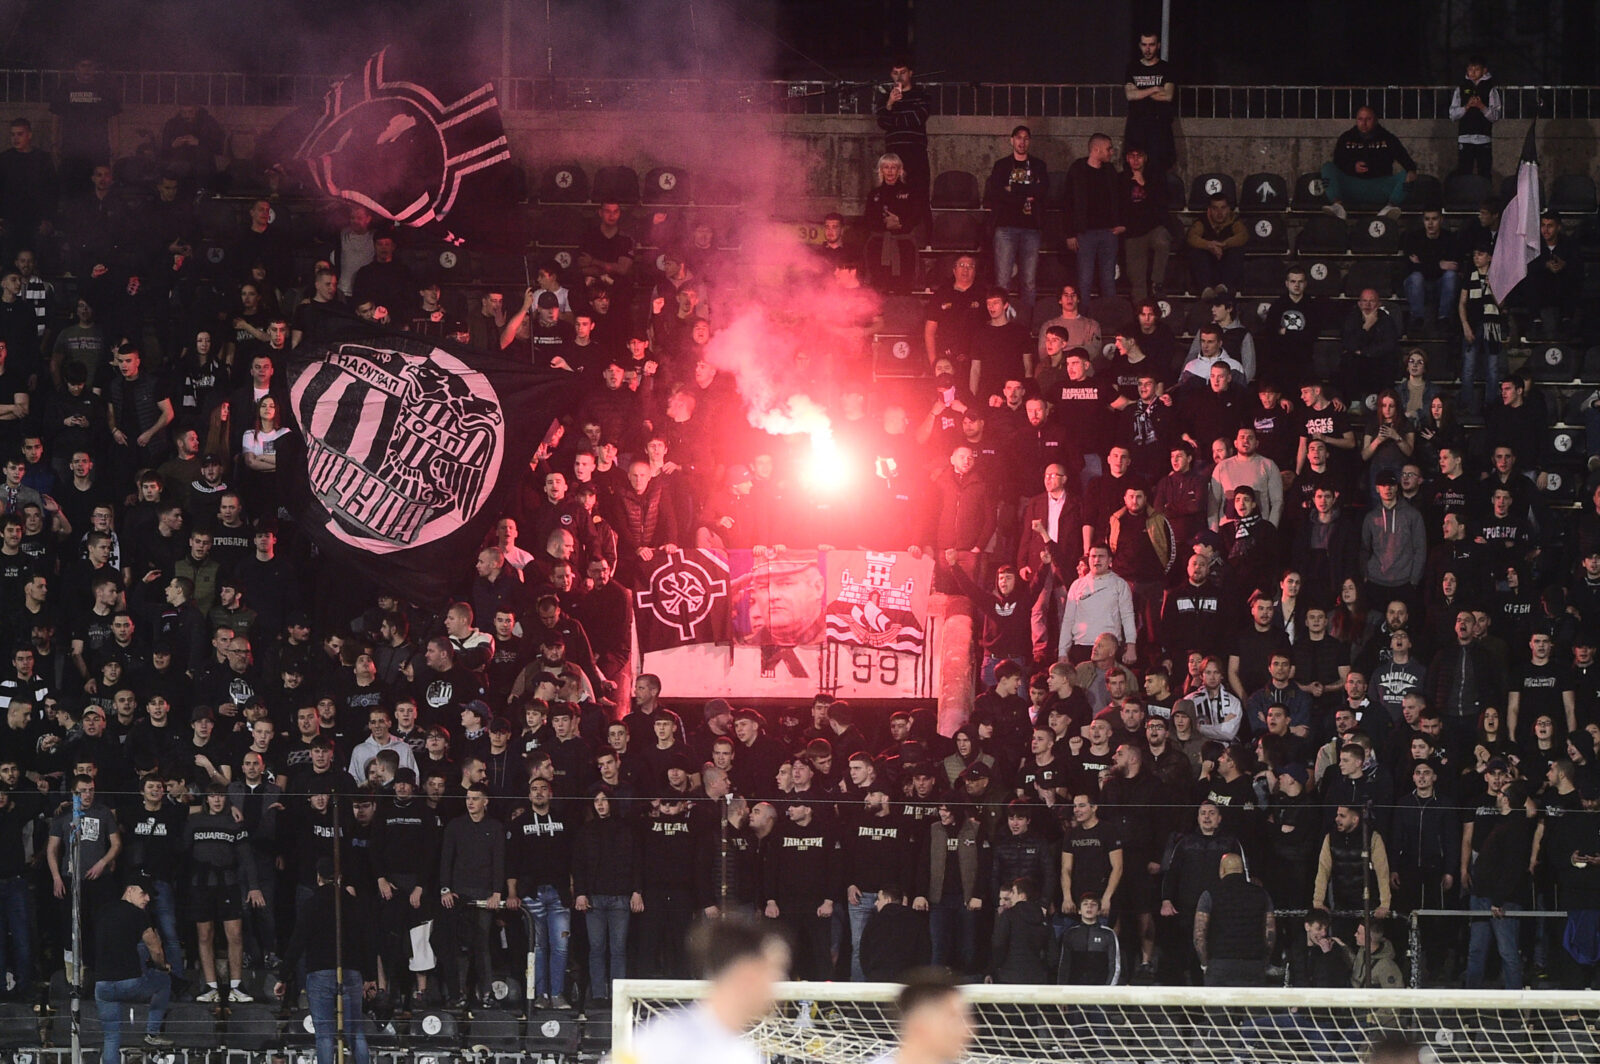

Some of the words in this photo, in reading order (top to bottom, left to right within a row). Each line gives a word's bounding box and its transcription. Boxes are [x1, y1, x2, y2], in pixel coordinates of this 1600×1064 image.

[798, 227, 818, 241] 30
[213, 536, 248, 547] ГРОБАРИ
[852, 652, 899, 686] 99
[782, 837, 823, 848] ЈАНГЕРИ
